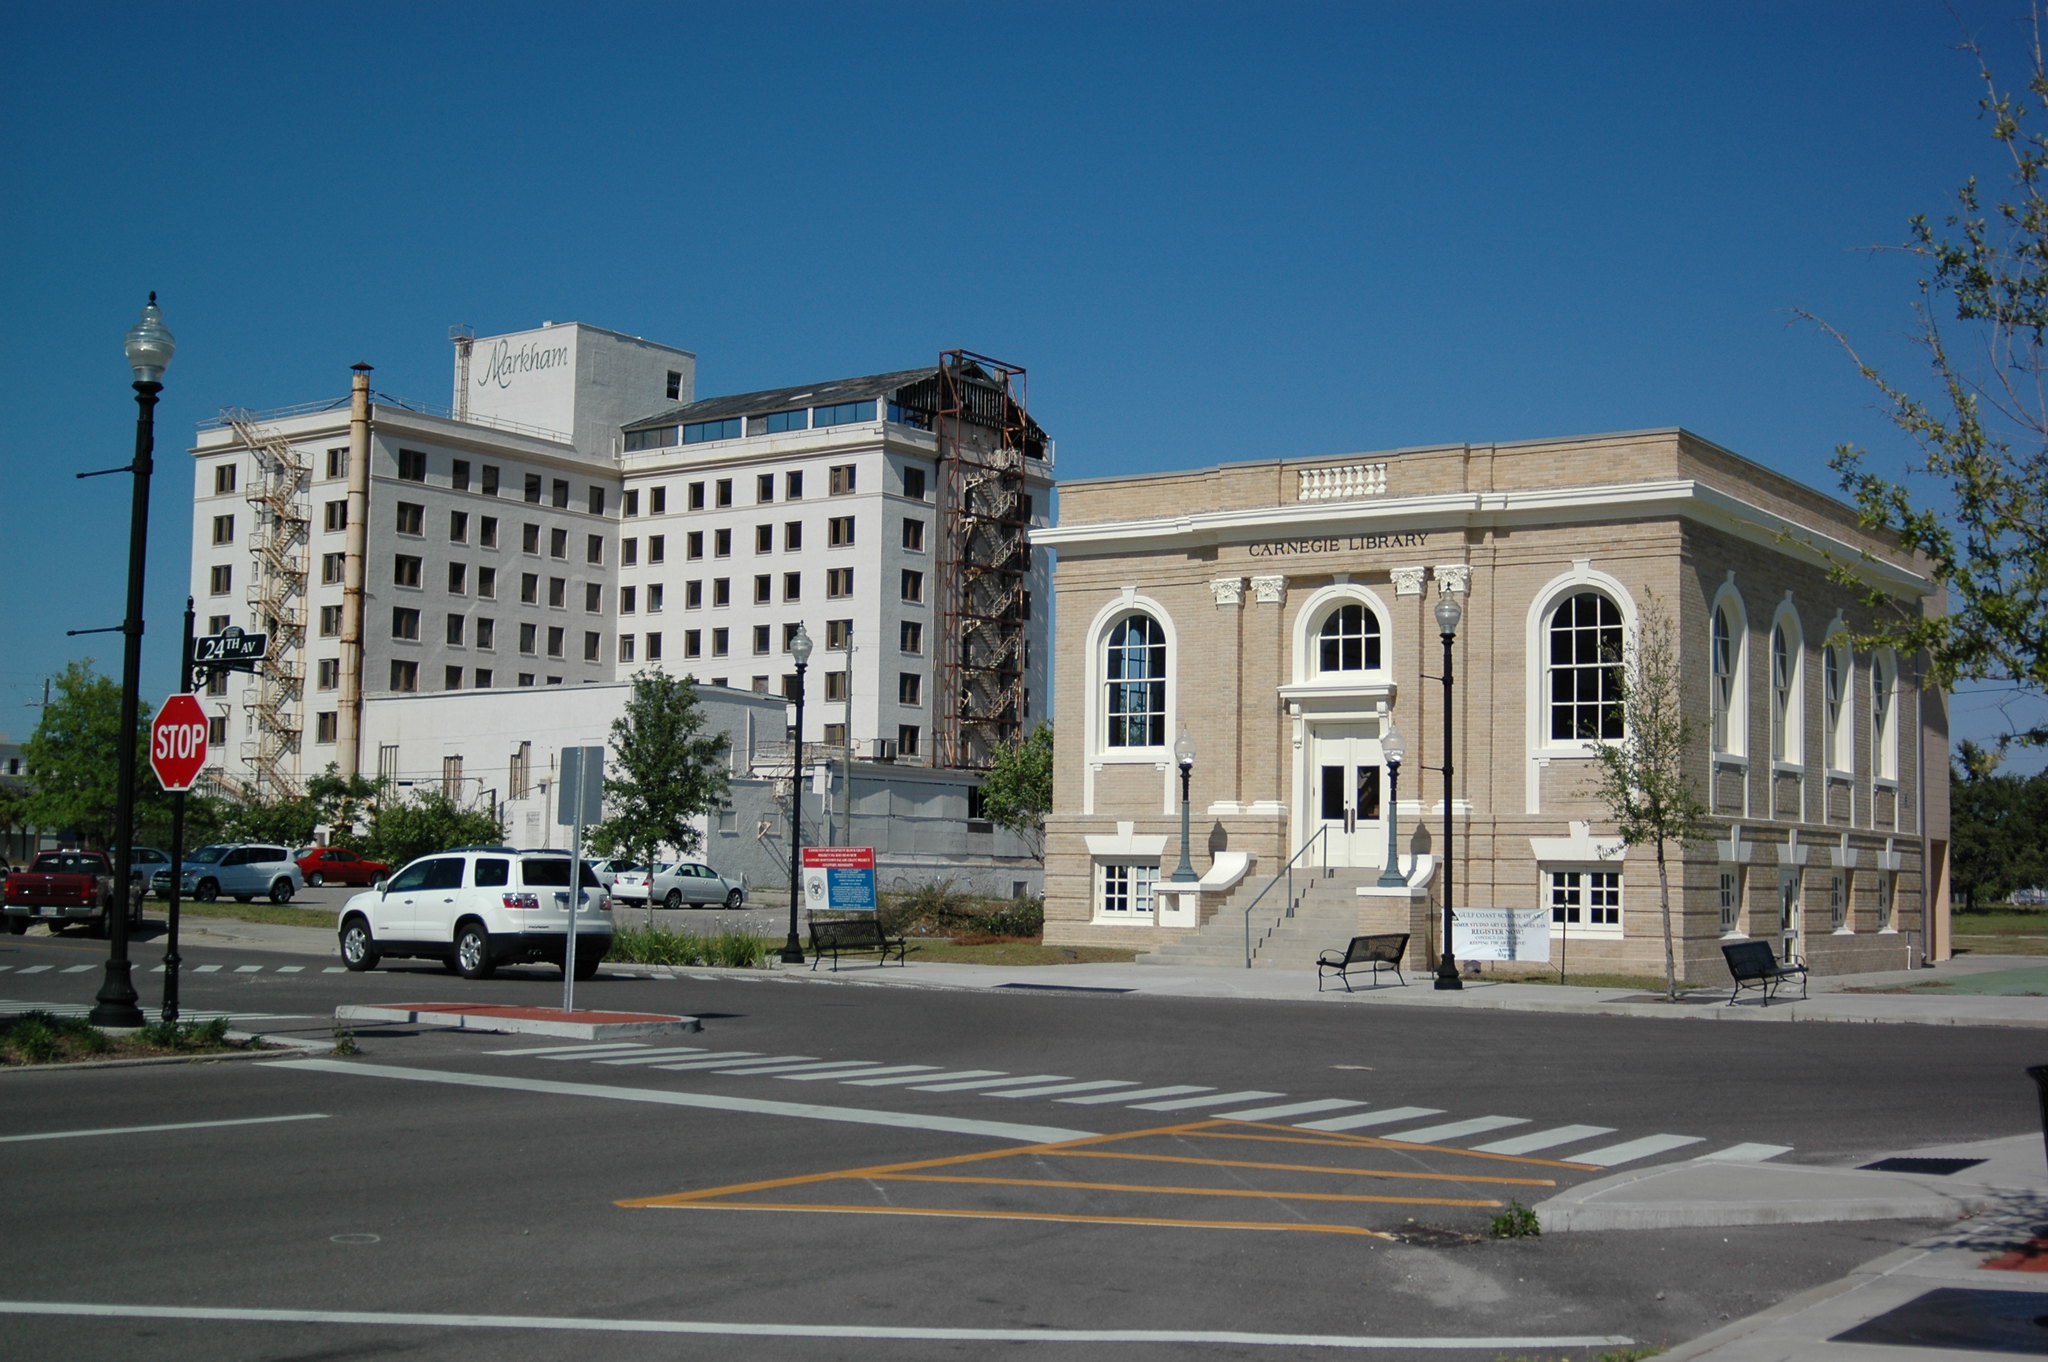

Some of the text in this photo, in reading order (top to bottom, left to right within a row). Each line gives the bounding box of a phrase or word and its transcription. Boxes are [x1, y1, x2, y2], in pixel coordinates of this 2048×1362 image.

[478, 339, 568, 388] Markham
[1249, 532, 1429, 557] CARNEGIE LIBRARY
[204, 638, 256, 659] 24TH AV
[156, 723, 205, 759] STOP
